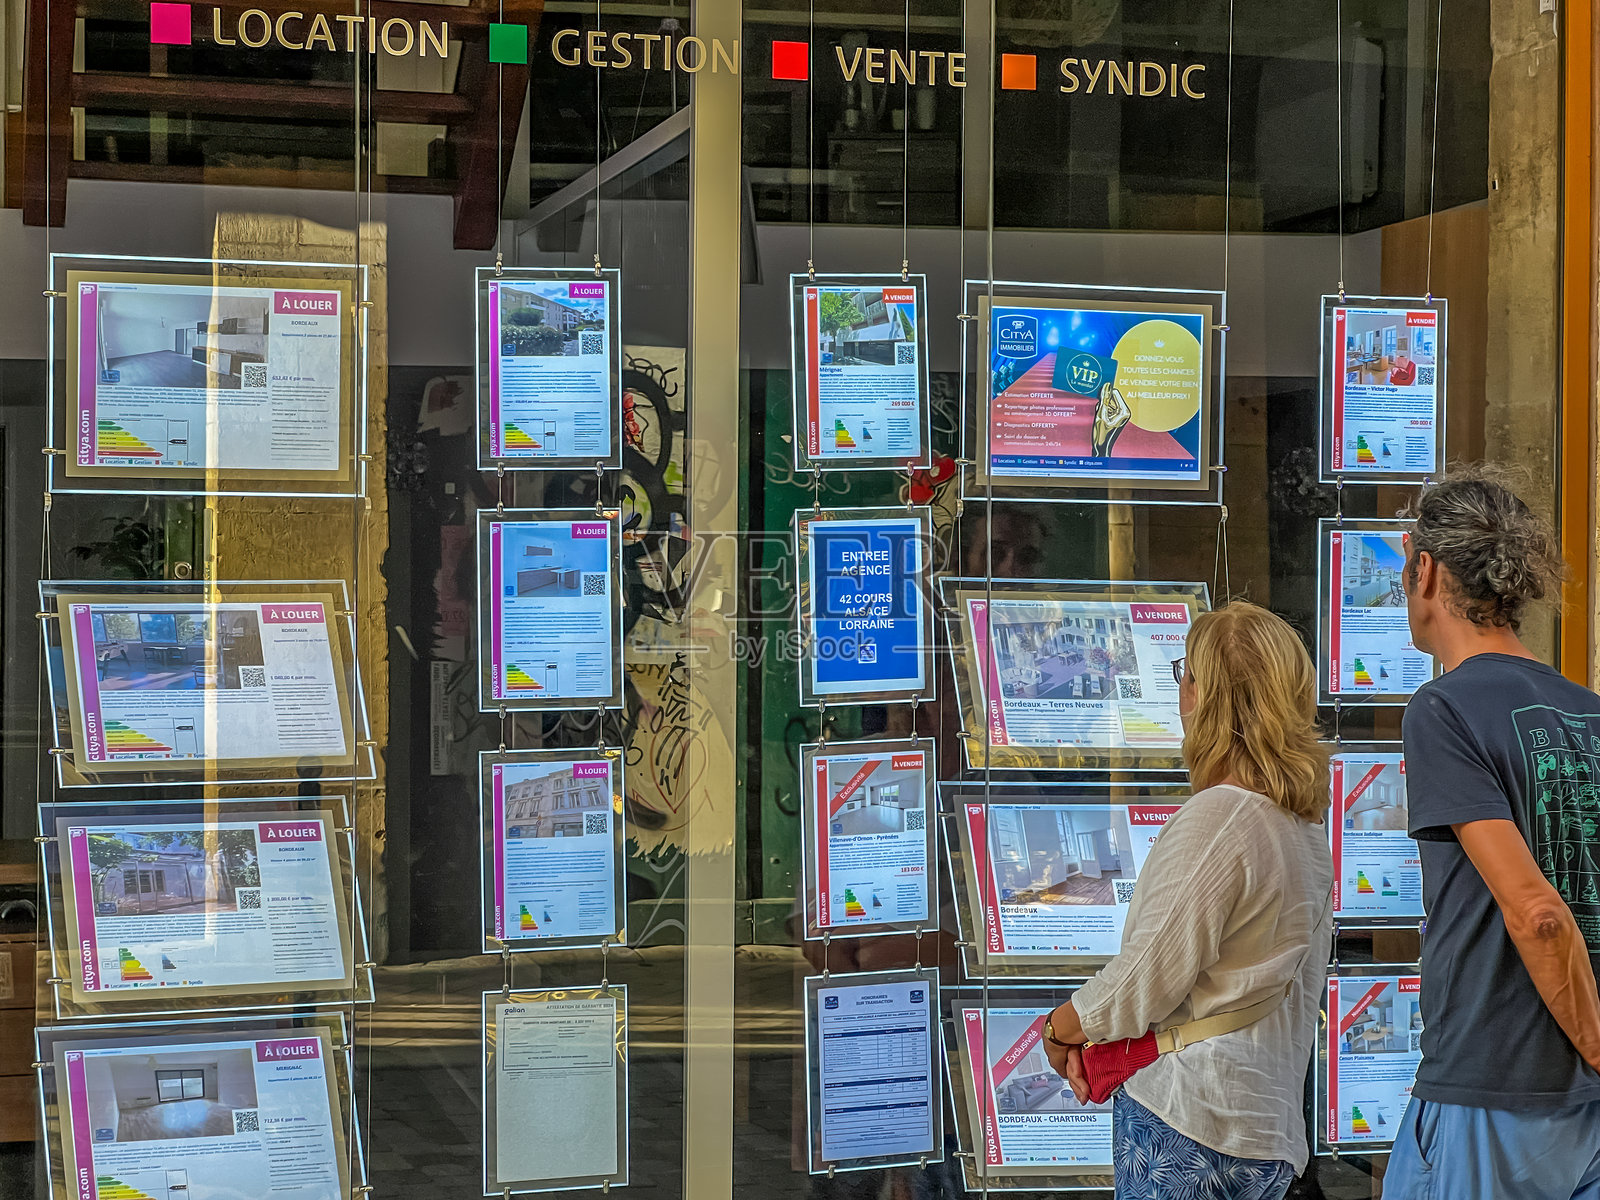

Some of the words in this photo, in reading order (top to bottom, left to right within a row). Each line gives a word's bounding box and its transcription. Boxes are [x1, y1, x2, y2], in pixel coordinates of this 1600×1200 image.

[212, 8, 450, 59] LOCATION
[551, 28, 741, 75] GESTION
[835, 45, 967, 89] VENTE
[1059, 57, 1207, 100] SYNDIC
[574, 286, 580, 295] À
[580, 287, 603, 296] LOUER
[884, 292, 890, 301] À
[282, 297, 291, 310] À
[293, 299, 333, 311] LOUER
[1000, 343, 1034, 353] IMMOBILIER
[819, 366, 842, 374] Mérignac
[1122, 366, 1149, 374] TOUTES
[1149, 366, 1161, 374] LES
[1162, 367, 1195, 376] CHANCES
[1119, 378, 1129, 386] DE
[1129, 379, 1158, 387] VENDRE
[1159, 380, 1181, 388] VOTRE
[1181, 380, 1198, 388] BIEN
[1138, 391, 1171, 399] MEILLEUR
[80, 408, 91, 465] citya.com
[810, 420, 818, 454] citya.com
[577, 527, 582, 536] À
[841, 550, 889, 562] ENTREE
[840, 564, 891, 577] AGENCE
[839, 594, 852, 605] 42
[854, 593, 893, 605] COURS
[270, 608, 279, 620] À
[280, 609, 320, 621] LOUER
[844, 605, 889, 618] ALSACE
[1136, 609, 1143, 620] À
[1144, 611, 1183, 620] VENDRE
[839, 619, 895, 632] LORRAINE
[1150, 633, 1164, 641] 407
[1166, 633, 1180, 641] 000
[1003, 700, 1041, 708] Bordeaux
[1048, 701, 1074, 709] Terres
[1075, 701, 1104, 709] Neuves
[990, 700, 1003, 745] citya.com
[89, 711, 101, 762] citya.com
[893, 760, 899, 768] À
[577, 766, 584, 775] À
[584, 767, 607, 776] LOUER
[839, 771, 866, 801] Exclusivité
[1134, 811, 1142, 821] À
[1143, 813, 1174, 822] VEND
[267, 827, 277, 839] À
[278, 827, 317, 839] LOUER
[820, 891, 829, 925] citya.com
[1001, 906, 1038, 914] Bordeaux
[989, 905, 1000, 952] citya.com
[83, 939, 95, 991] citya.com
[264, 1044, 275, 1058] À
[276, 1044, 315, 1057] LOUER
[1004, 1028, 1040, 1066] Exclusivité
[998, 1115, 1042, 1124] BORDEAUX
[1048, 1115, 1097, 1123] CHARTRONS
[986, 1115, 998, 1163] citya.com
